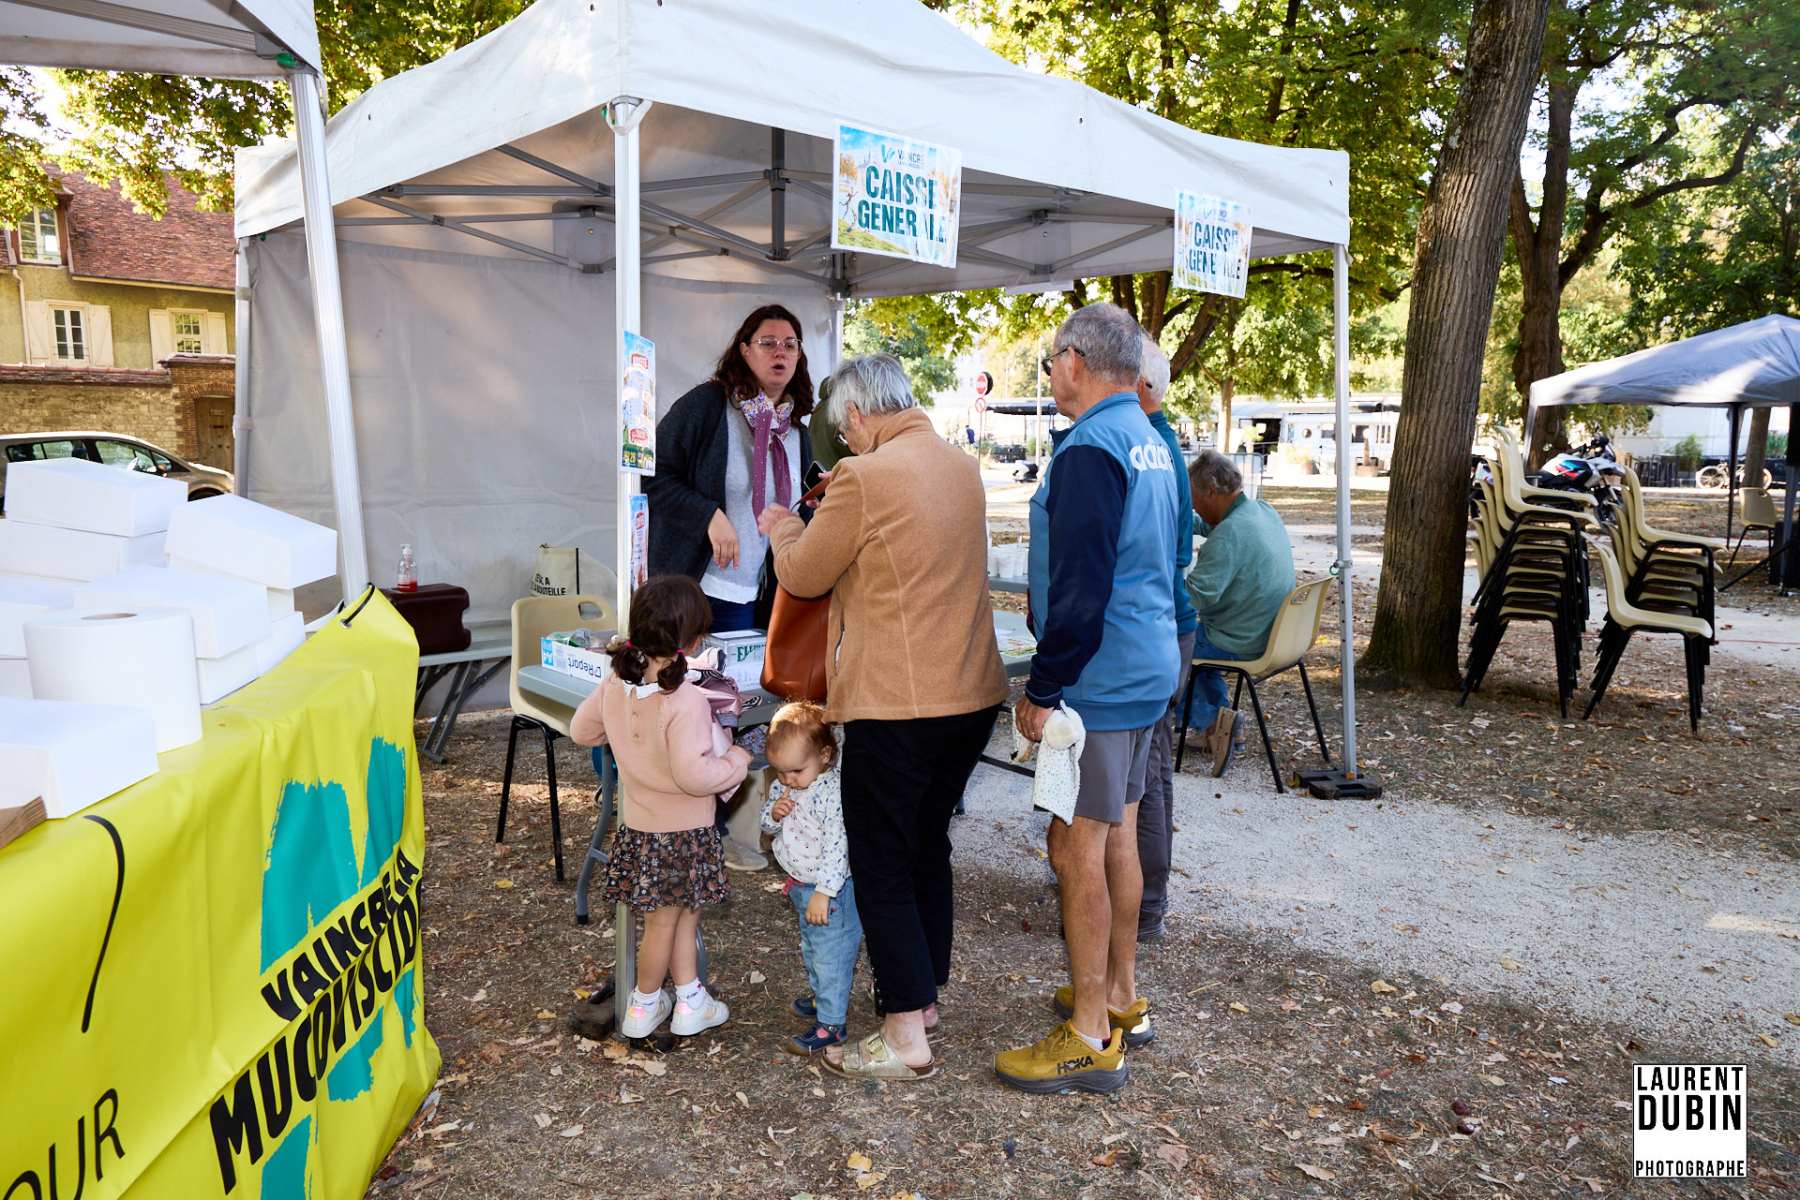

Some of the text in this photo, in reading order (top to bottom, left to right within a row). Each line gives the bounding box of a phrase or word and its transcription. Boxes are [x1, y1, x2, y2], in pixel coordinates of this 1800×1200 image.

[857, 199, 947, 244] GENERL
[261, 871, 392, 1022] VAINCRE
[209, 877, 422, 1196] MUCOVISCID
[1057, 1055, 1094, 1075] HOKA
